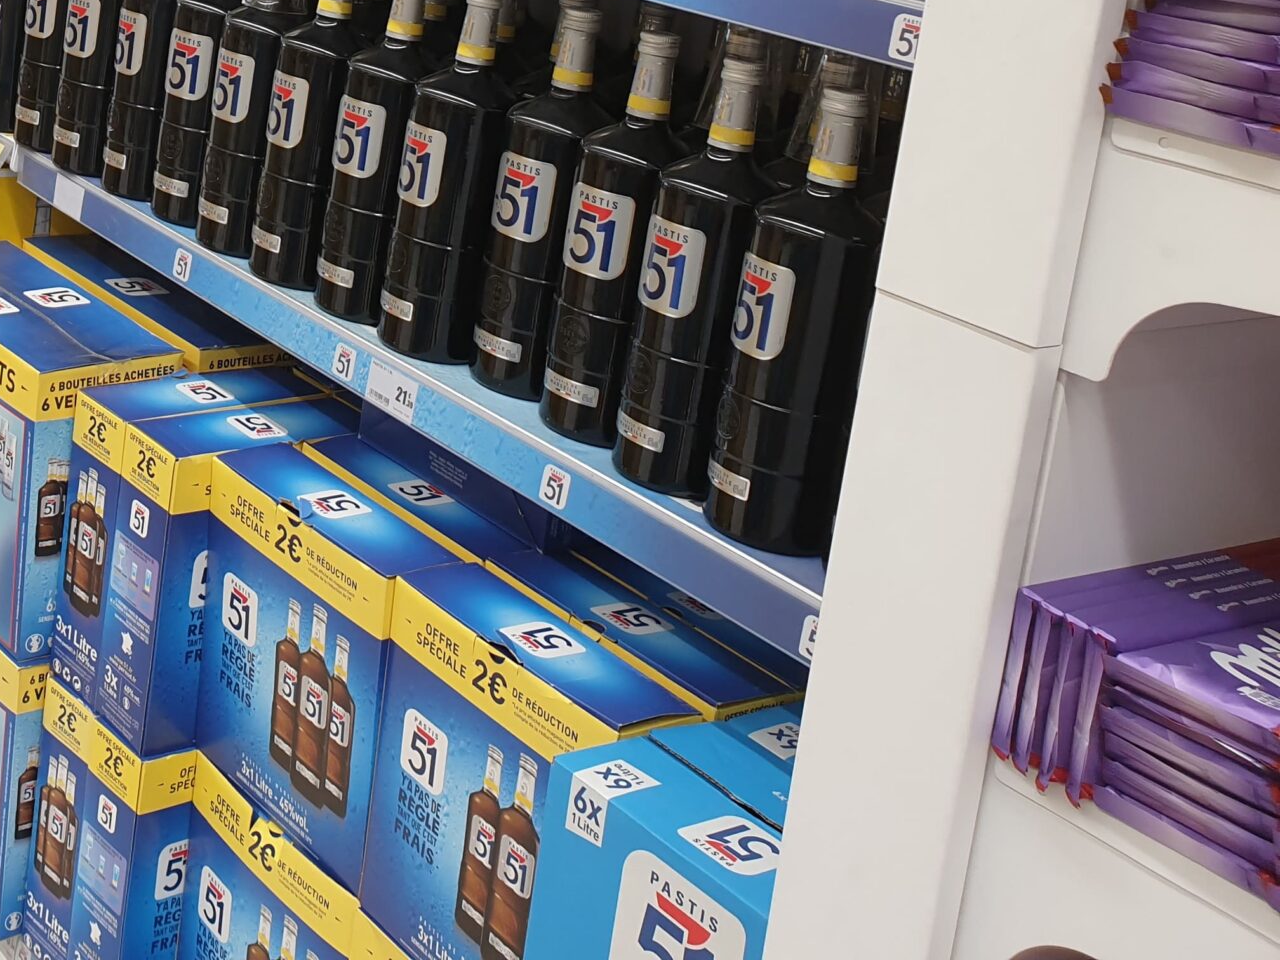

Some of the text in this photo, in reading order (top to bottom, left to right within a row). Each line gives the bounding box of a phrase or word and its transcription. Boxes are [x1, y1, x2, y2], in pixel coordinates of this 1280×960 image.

[65, 12, 90, 52] 51
[169, 50, 201, 95] 51
[214, 70, 242, 117] 51
[334, 120, 371, 172] 51
[505, 157, 541, 176] PASTIS
[399, 145, 432, 200] 51
[495, 174, 539, 236] 51
[580, 190, 618, 210] PASTIS
[569, 211, 616, 273] 51
[652, 222, 689, 244] PASTIS
[642, 244, 686, 310] 51
[744, 258, 778, 282] PASTIS
[733, 280, 774, 351] 51
[50, 364, 175, 393] 6 BOUTEILLES ACHETÉES
[88, 416, 106, 443] 2€
[137, 450, 156, 478] 2€
[230, 504, 270, 543] SPÉCIALE
[236, 494, 265, 524] OFFRE
[274, 523, 303, 564] 2€
[306, 546, 358, 591] DE RÉDUCTION
[55, 615, 97, 661] 3x1 Litre
[228, 591, 250, 640] 51
[416, 631, 467, 681] SPÉCIALE
[425, 622, 460, 659] OFFRE
[471, 658, 508, 706] 2€
[511, 686, 579, 744] DE RÉDUCTION
[240, 761, 254, 782] 3x1
[255, 773, 273, 801] Litre
[407, 732, 438, 789] 51
[209, 799, 245, 847] SPÉCIALE
[216, 794, 241, 828] OFFRE
[248, 830, 276, 873] 2€
[706, 824, 780, 862] 51
[201, 888, 226, 934] 51
[287, 866, 330, 911] RÉDUCTION
[650, 870, 720, 935] PASTIS
